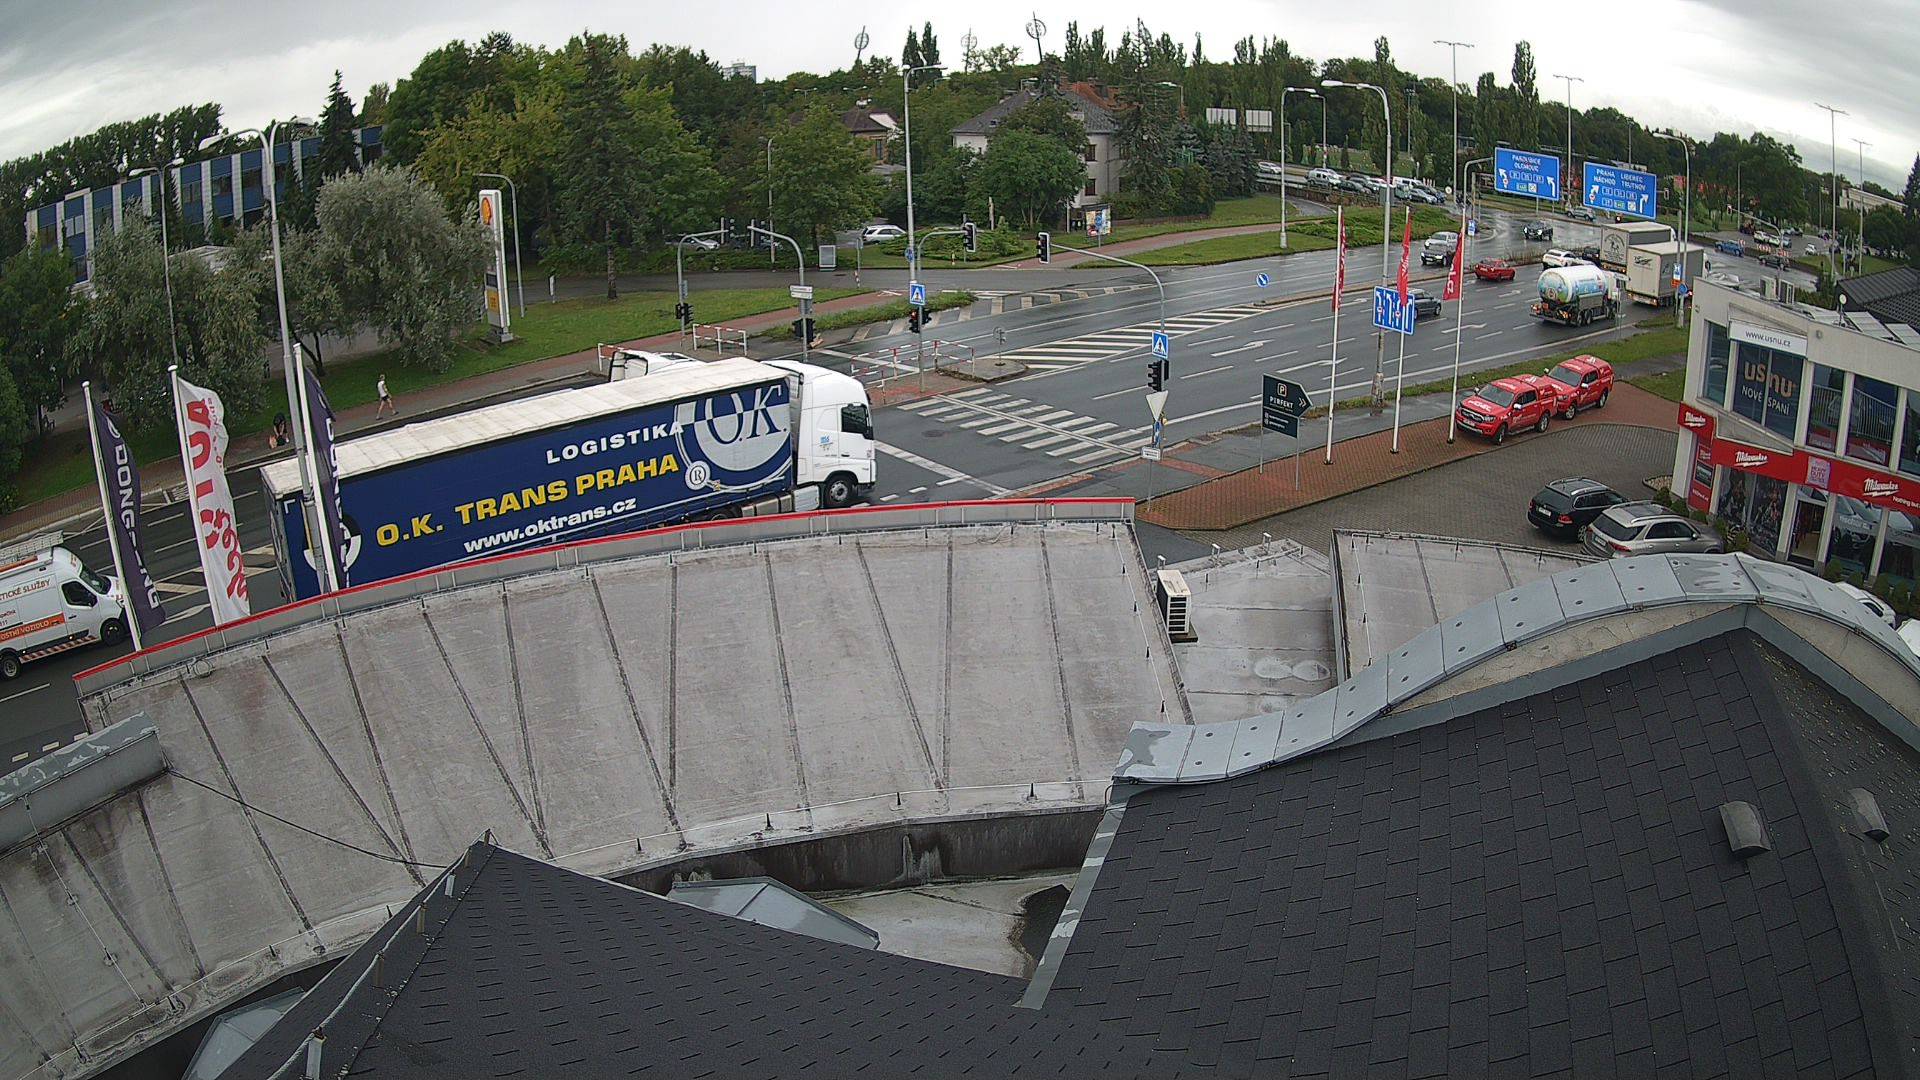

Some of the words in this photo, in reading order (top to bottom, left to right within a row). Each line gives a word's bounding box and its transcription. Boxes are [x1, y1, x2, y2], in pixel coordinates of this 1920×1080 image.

[1745, 331, 1791, 347] www.usnu.cz
[1270, 396, 1294, 409] PERFEKT
[547, 422, 684, 464] LOGISTIKA
[376, 513, 444, 547] O.K.
[455, 480, 568, 525] TRANS
[575, 454, 679, 495] PRAHA
[463, 497, 638, 553] www.oktrans.cz
[22, 579, 50, 593] SLUŽBY
